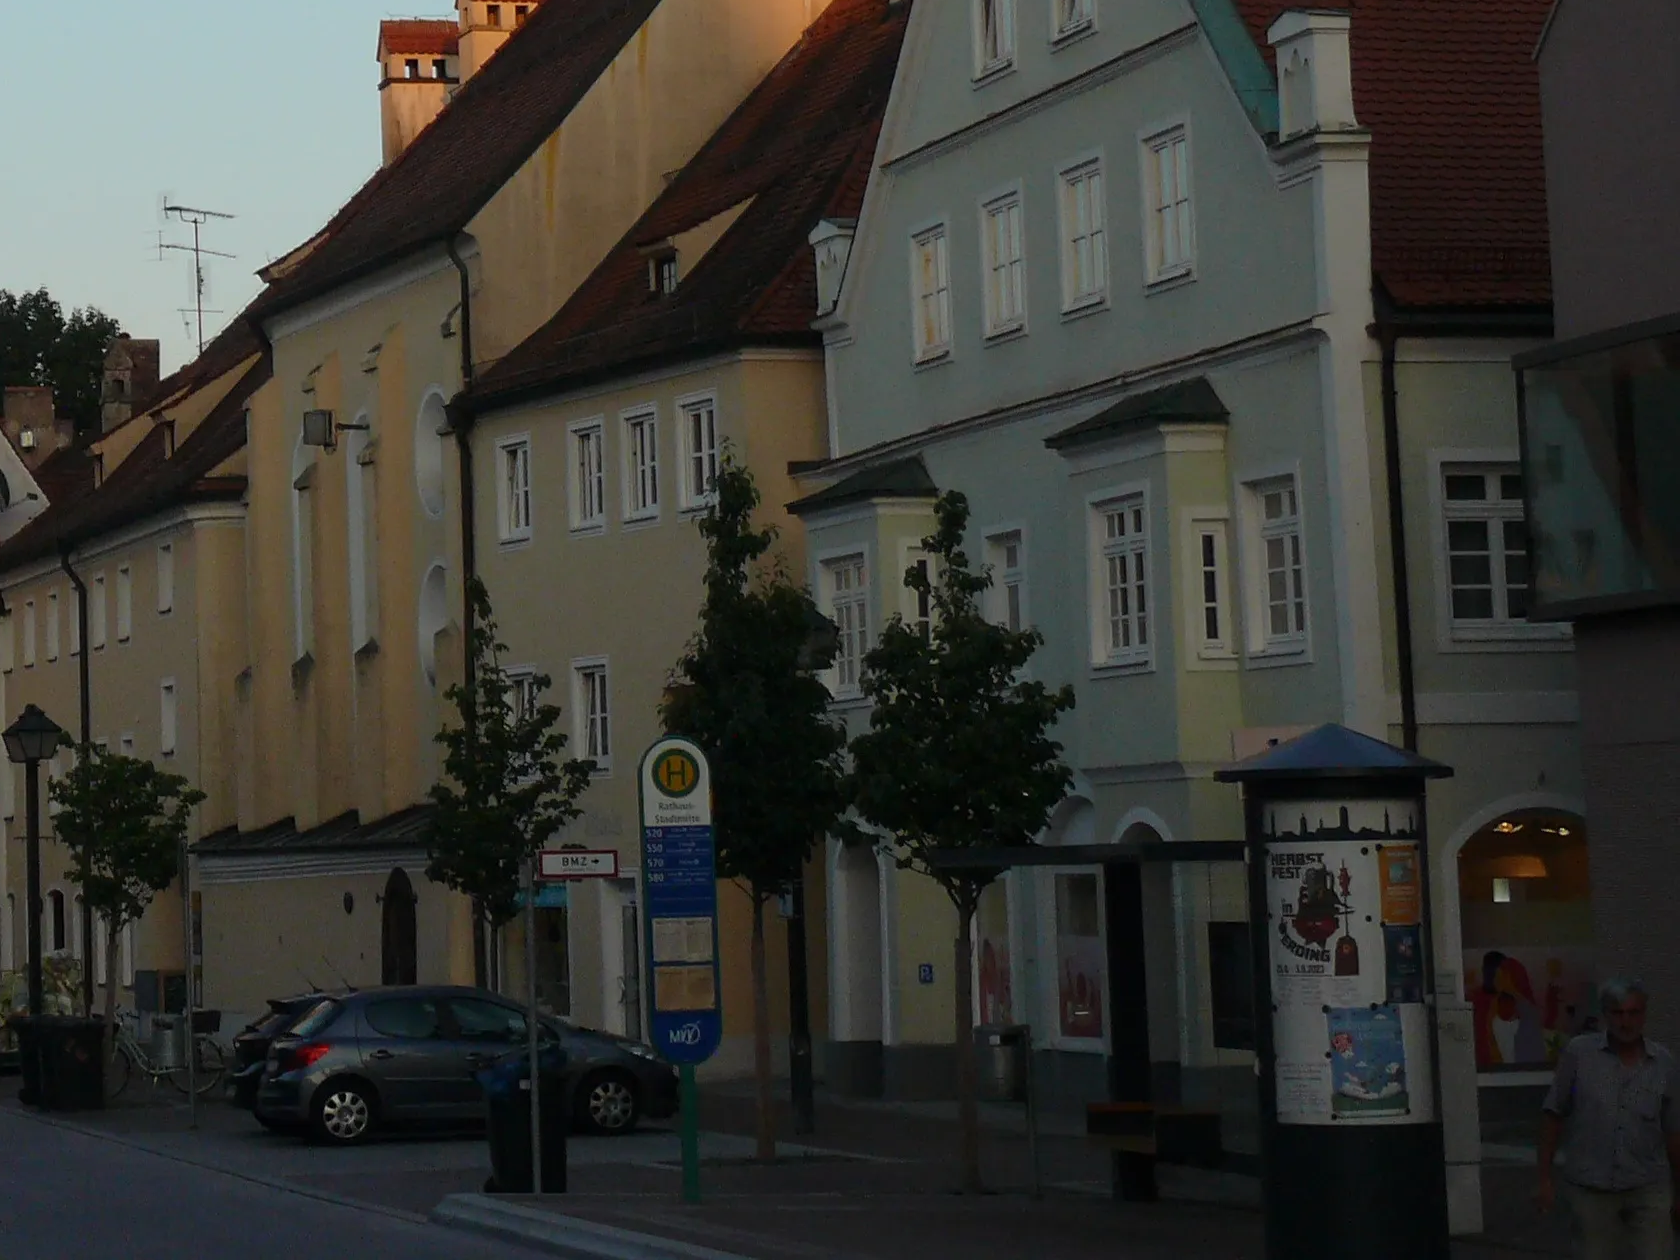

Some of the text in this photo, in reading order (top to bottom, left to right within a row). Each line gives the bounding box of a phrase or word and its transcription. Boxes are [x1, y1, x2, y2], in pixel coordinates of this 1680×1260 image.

[666, 759, 687, 788] H
[645, 828, 663, 838] 520
[646, 843, 663, 853] 550
[562, 857, 587, 867] BMZ
[647, 858, 664, 868] 570
[1270, 853, 1324, 866] HERBST
[1272, 867, 1301, 879] FEST
[1280, 936, 1331, 963] ERDING
